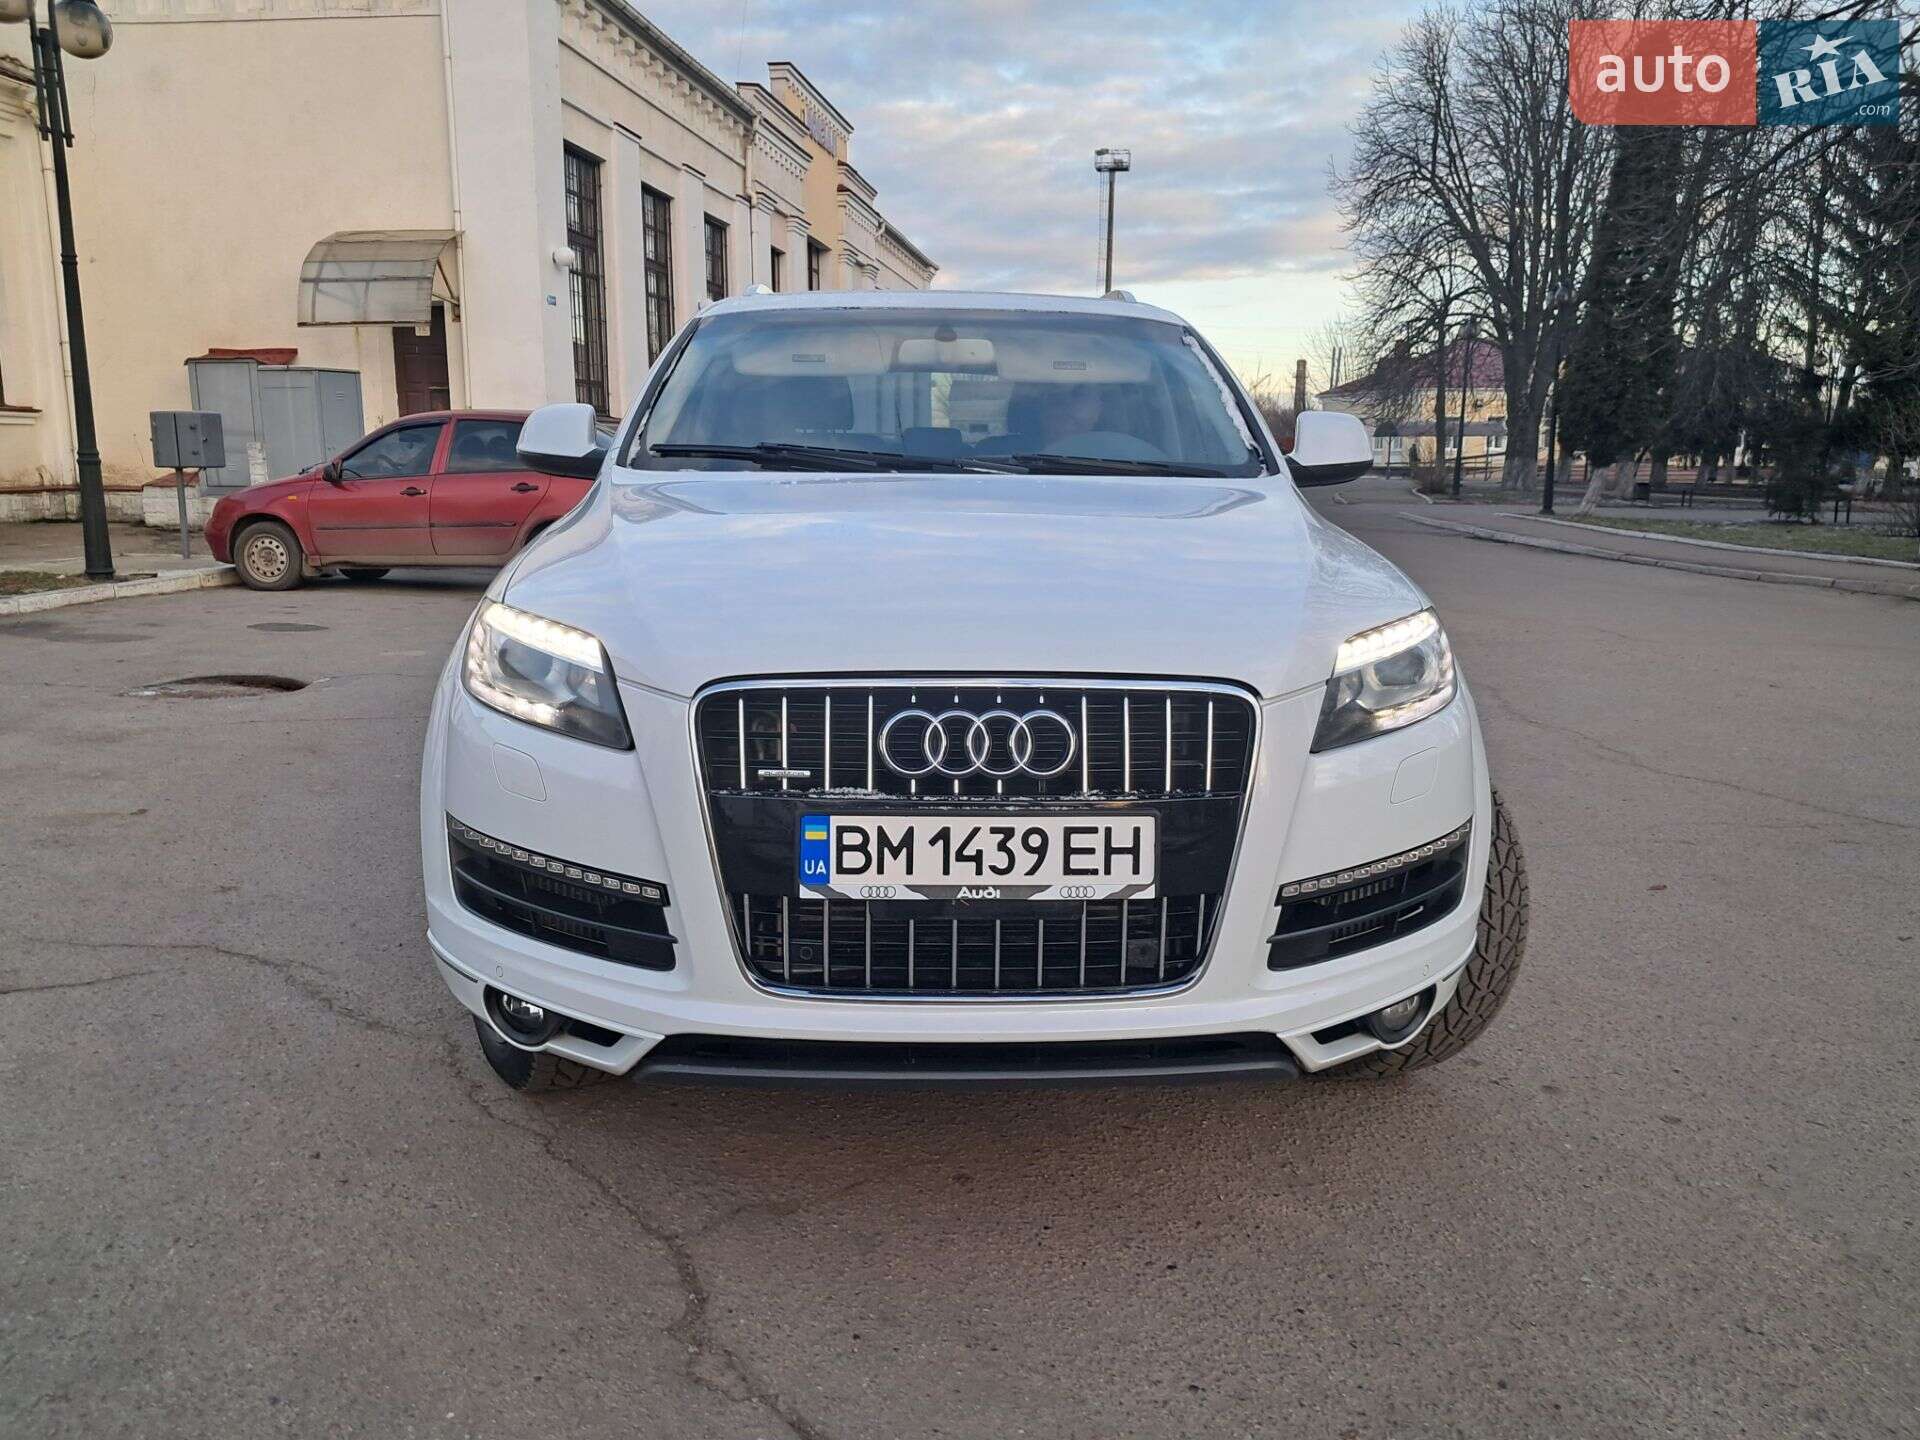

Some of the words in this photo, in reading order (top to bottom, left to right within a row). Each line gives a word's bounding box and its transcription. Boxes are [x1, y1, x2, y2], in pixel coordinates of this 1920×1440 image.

[835, 825, 914, 875] BM
[928, 826, 1049, 876] 1439
[1063, 826, 1141, 875] EH
[804, 860, 827, 875] UA
[957, 885, 1000, 899] Audi
